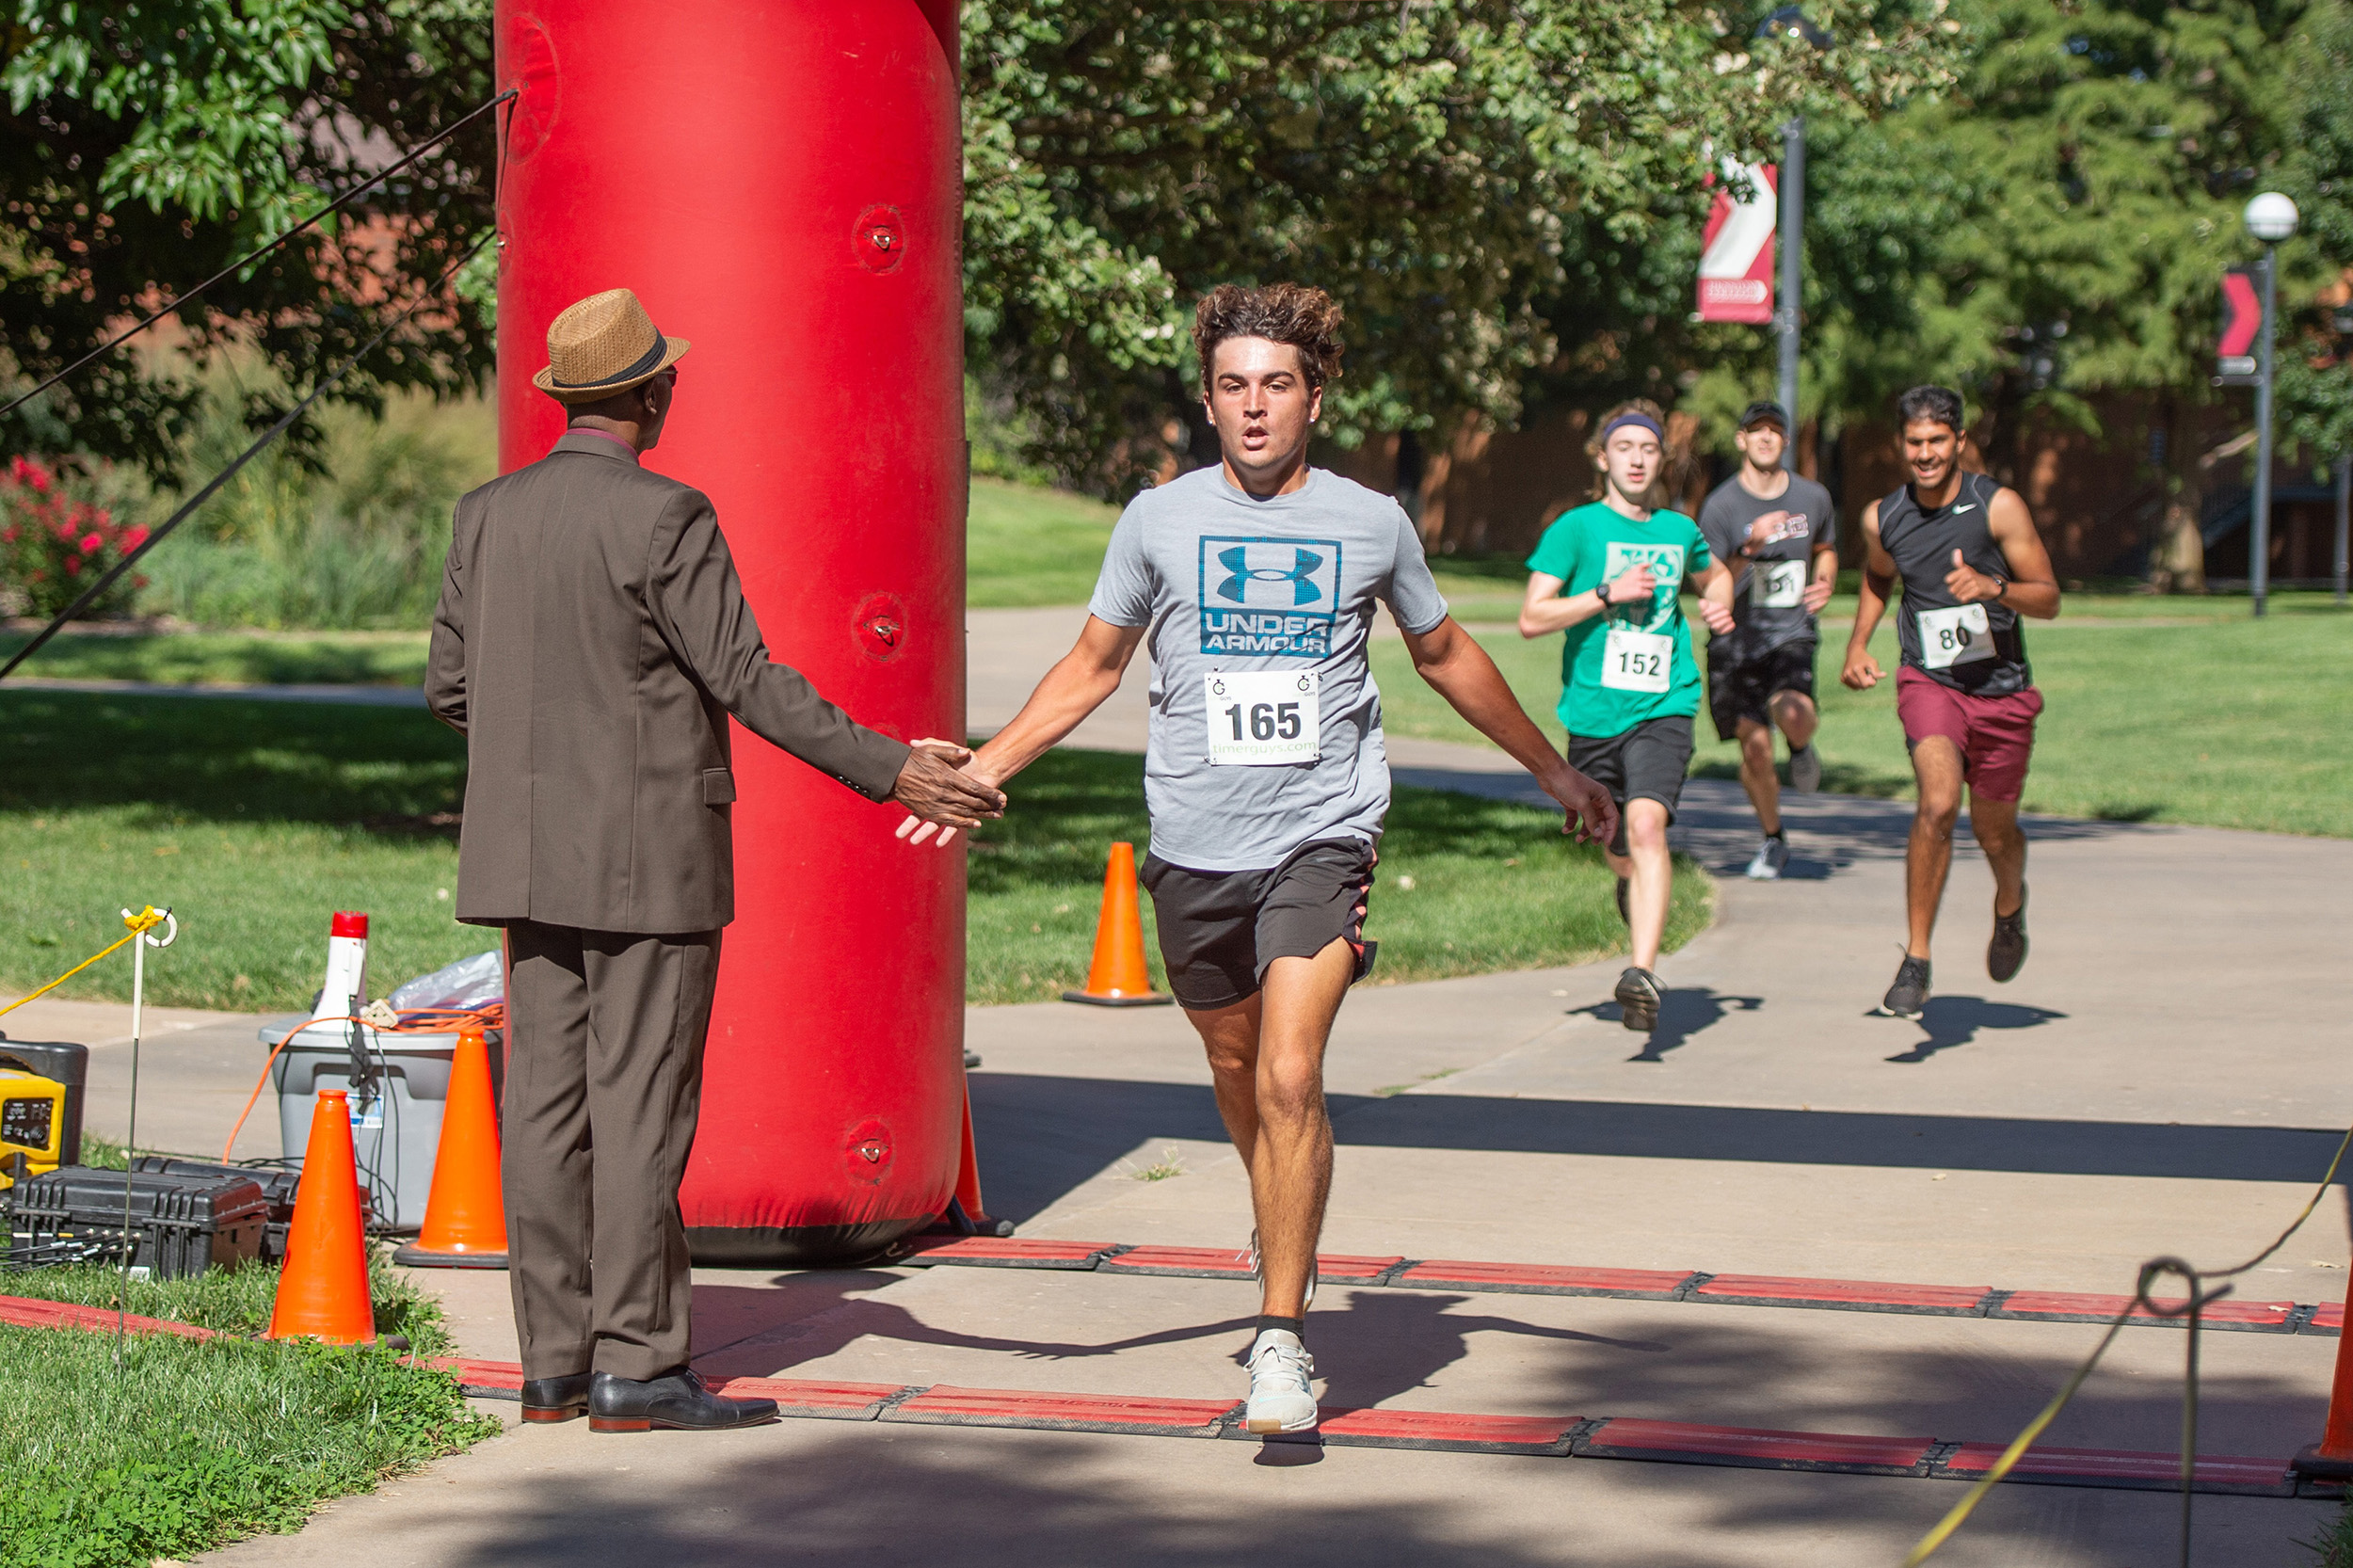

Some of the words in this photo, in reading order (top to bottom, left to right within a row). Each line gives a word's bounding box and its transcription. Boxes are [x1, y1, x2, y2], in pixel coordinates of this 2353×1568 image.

[1205, 613, 1329, 637] UNDER
[1205, 634, 1326, 653] ARMOUR
[1940, 626, 1971, 650] 80
[1619, 651, 1660, 677] 152
[1225, 702, 1302, 741] 165
[1213, 741, 1317, 756] timerguys.com
